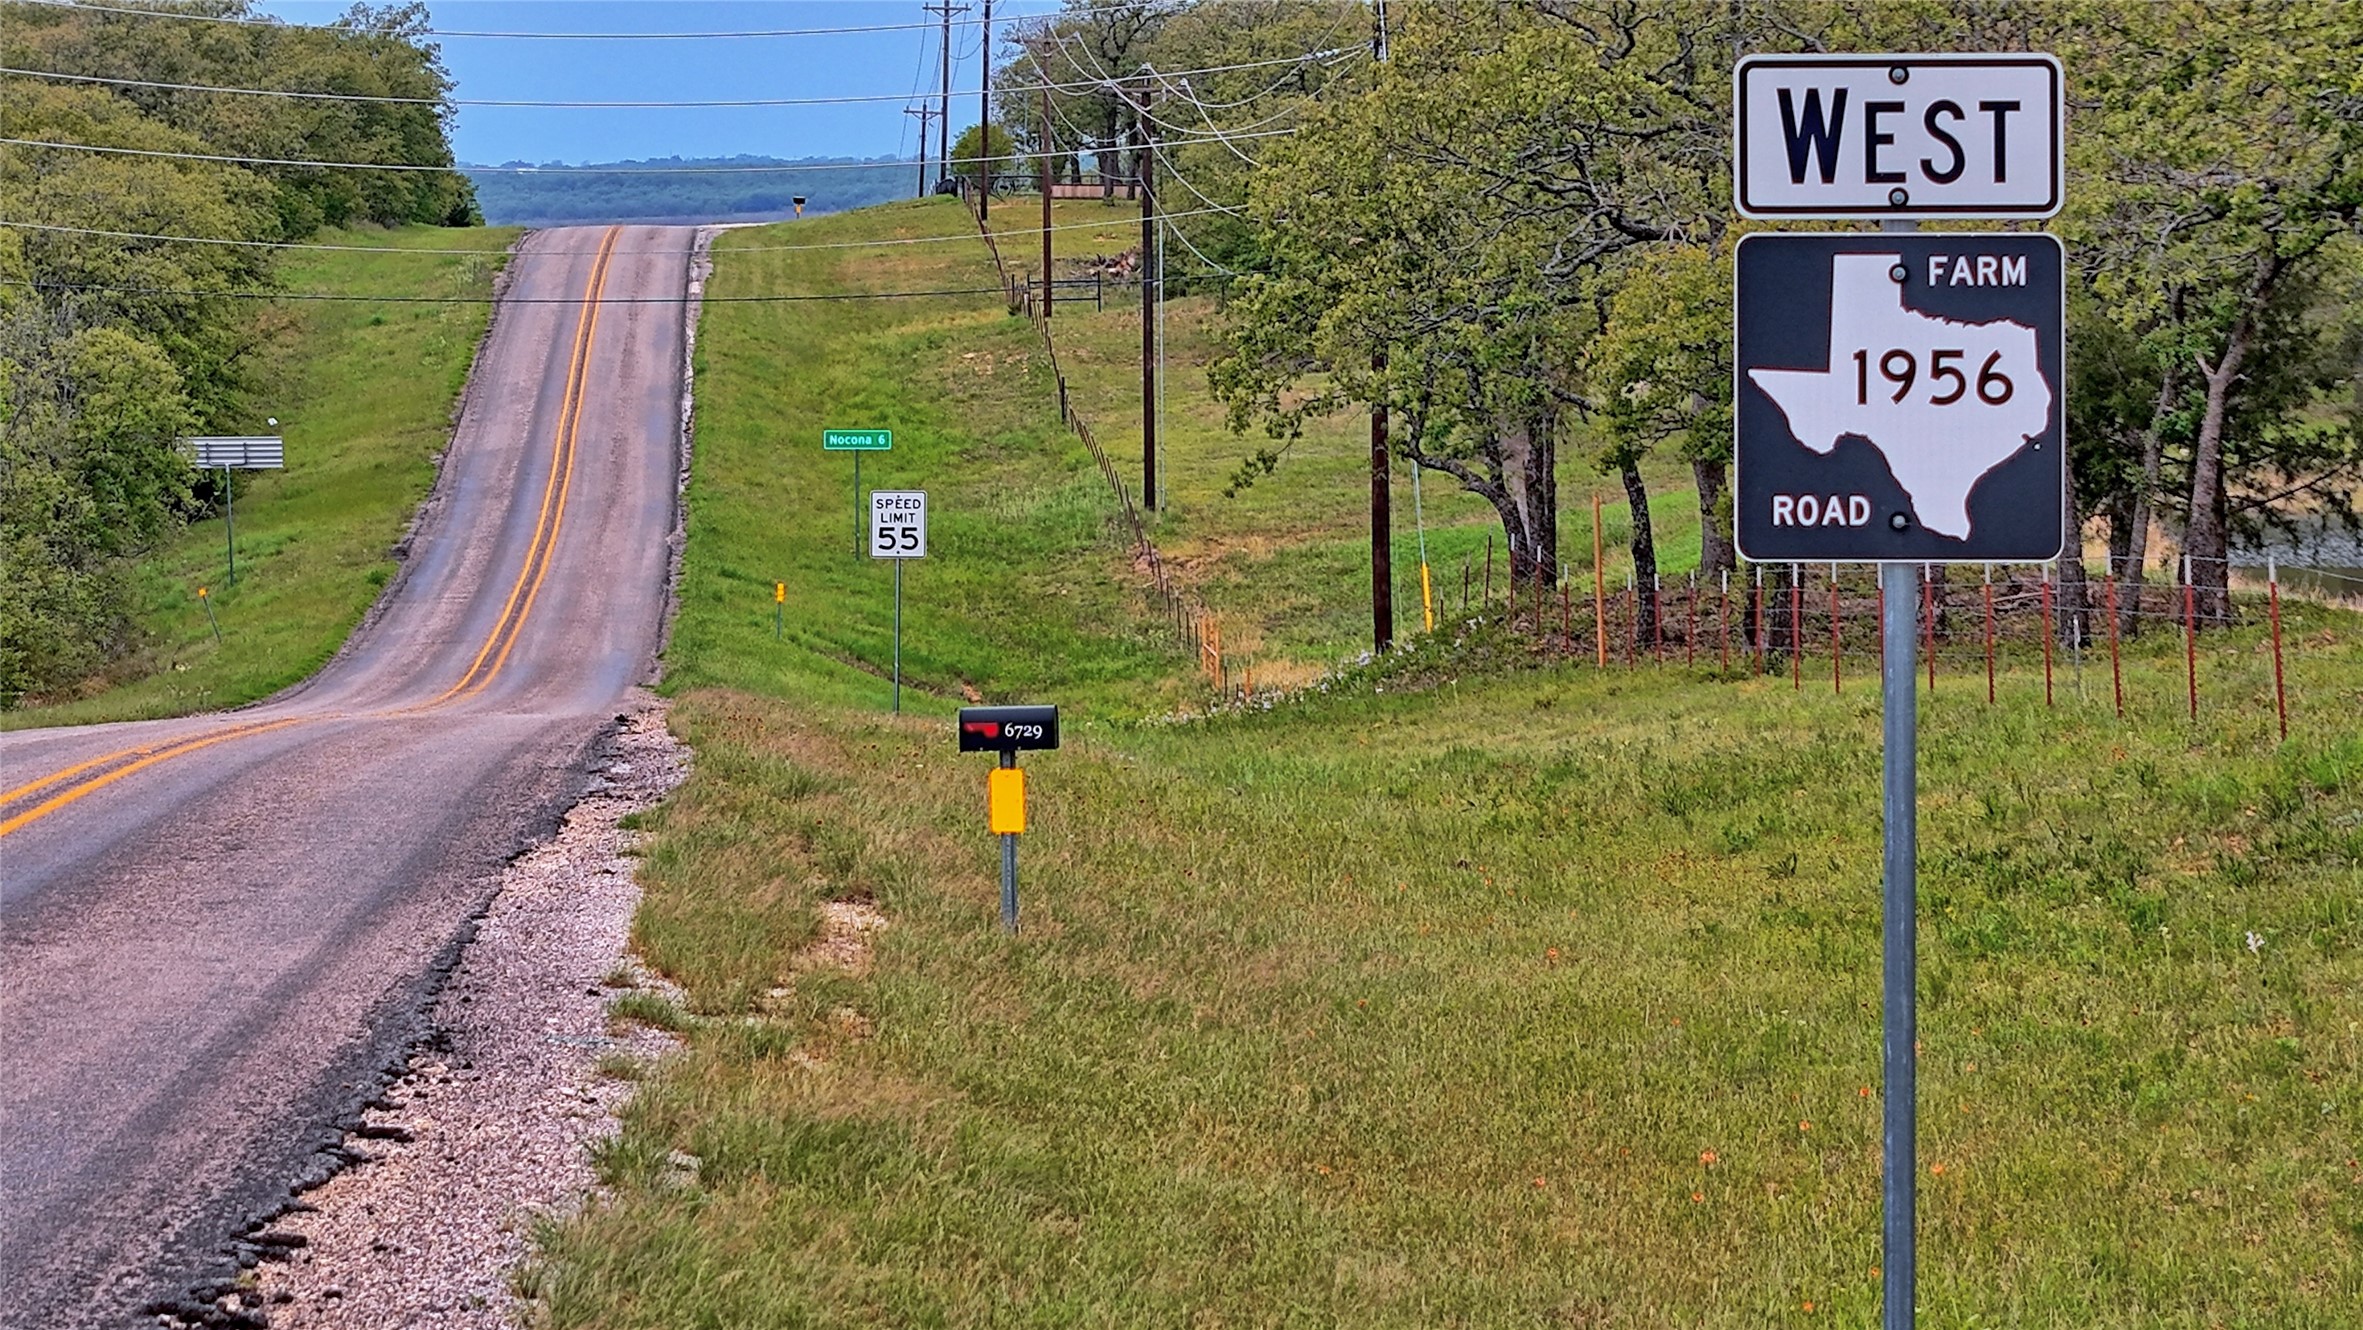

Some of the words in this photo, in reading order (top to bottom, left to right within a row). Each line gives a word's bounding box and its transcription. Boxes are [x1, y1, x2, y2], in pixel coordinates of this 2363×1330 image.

[1776, 87, 2021, 185] WEST
[1928, 255, 2027, 287] FARM
[1853, 348, 2014, 406] 1956
[829, 434, 872, 445] Nocona
[878, 434, 886, 445] 6
[876, 499, 921, 509] SPEED
[1772, 495, 1871, 526] ROAD
[881, 513, 916, 523] LIMIT
[878, 527, 919, 550] 55
[1004, 722, 1043, 740] 6729
